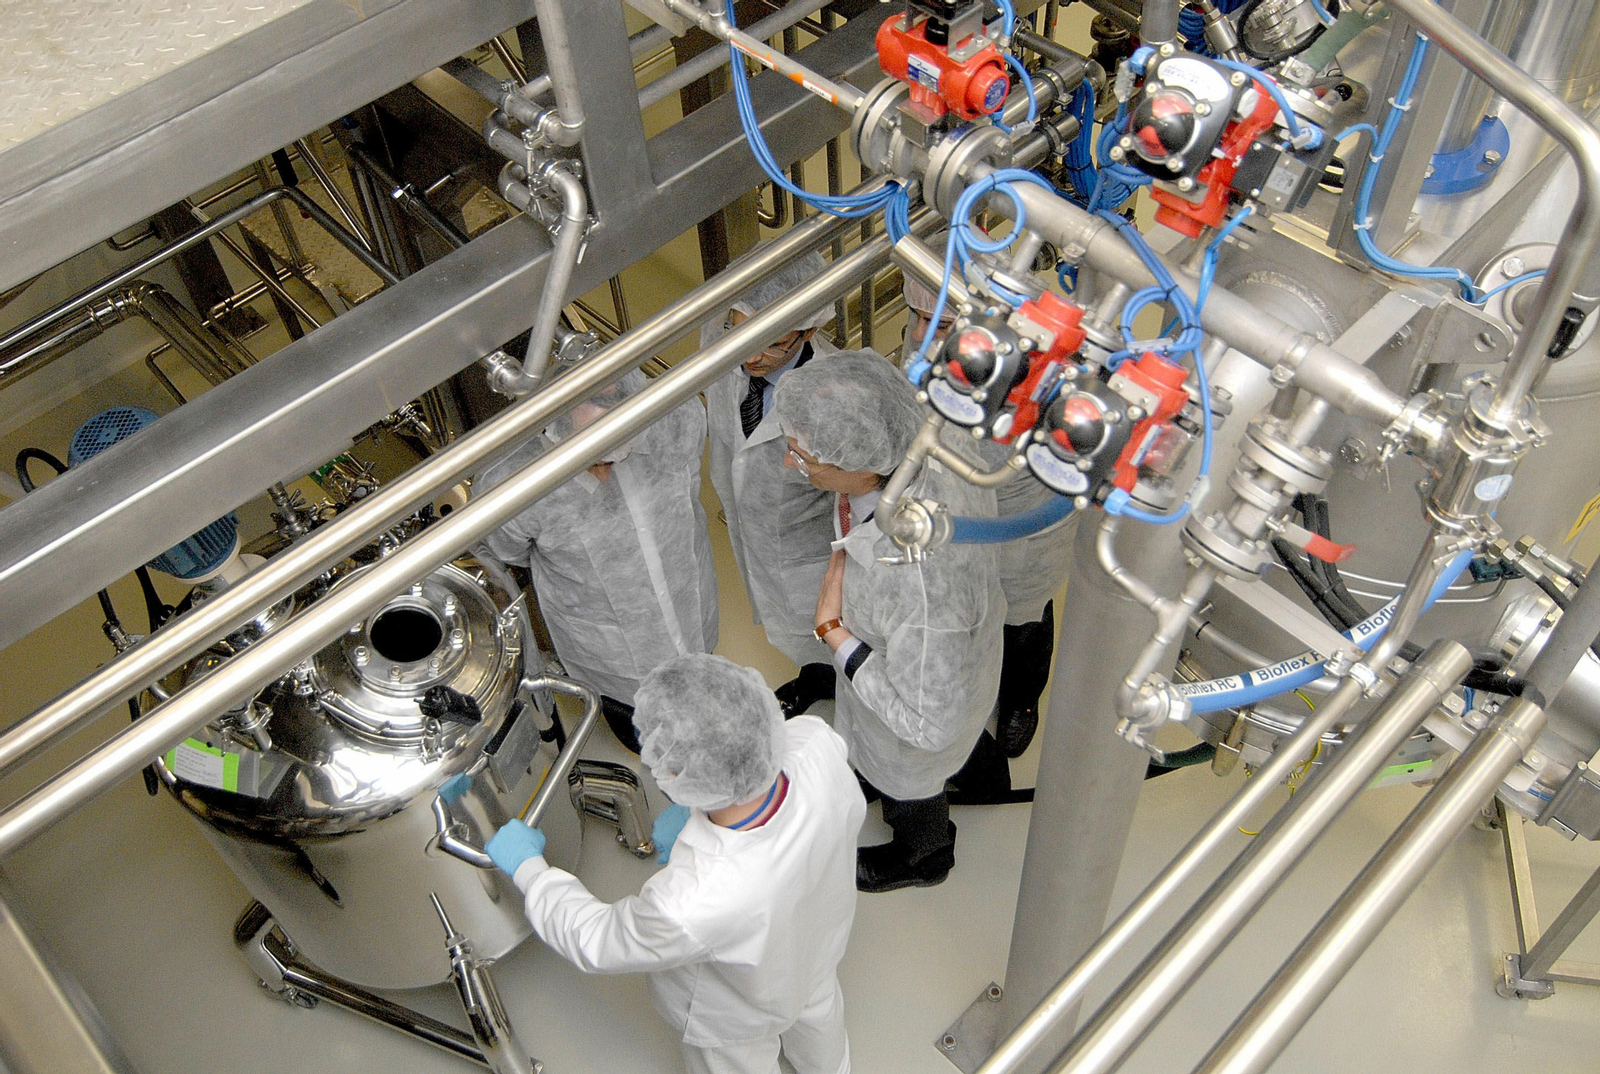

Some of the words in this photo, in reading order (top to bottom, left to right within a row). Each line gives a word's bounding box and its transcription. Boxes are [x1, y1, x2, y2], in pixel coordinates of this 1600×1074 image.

[1356, 604, 1397, 636] Biofle
[1256, 656, 1310, 681] Bioflex
[1214, 677, 1237, 691] RC
